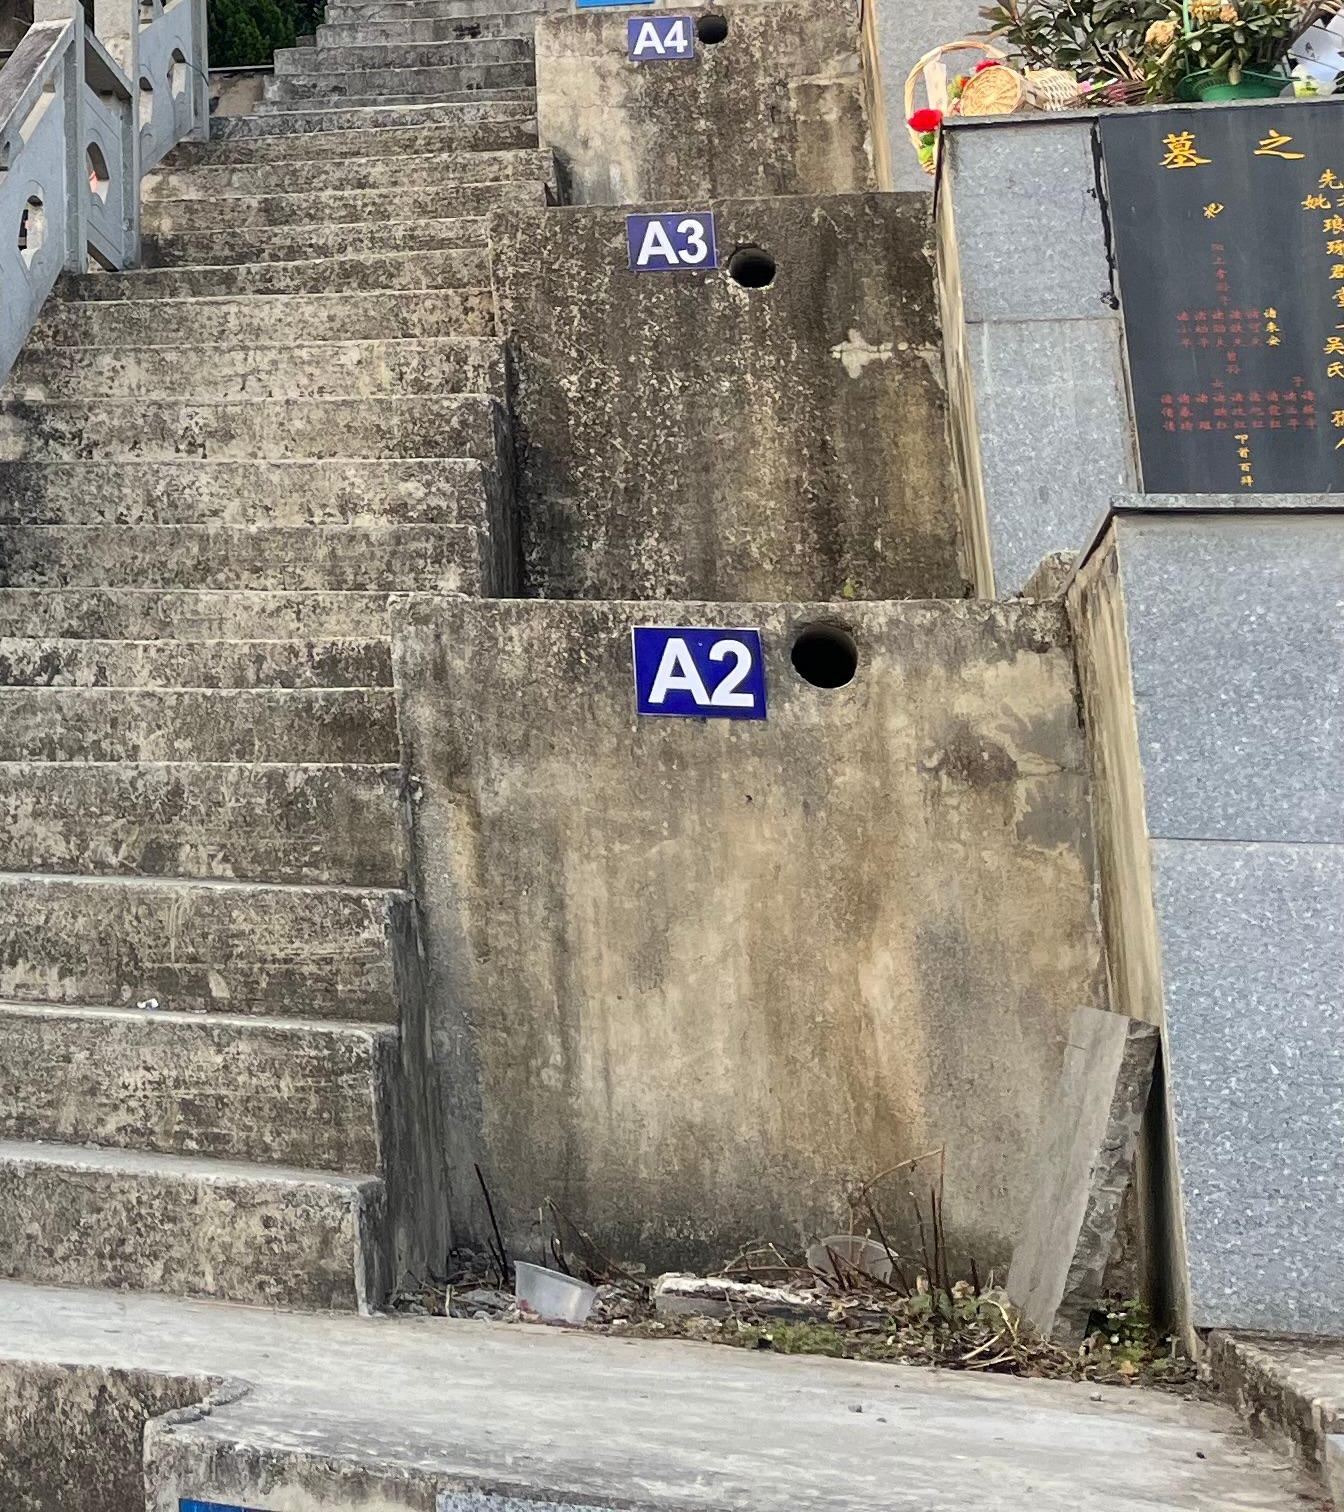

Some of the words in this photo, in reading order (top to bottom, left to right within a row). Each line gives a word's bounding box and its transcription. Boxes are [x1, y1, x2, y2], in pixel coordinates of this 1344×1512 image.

[633, 20, 688, 55] A4
[637, 219, 708, 265] A3
[648, 637, 755, 707] A2
